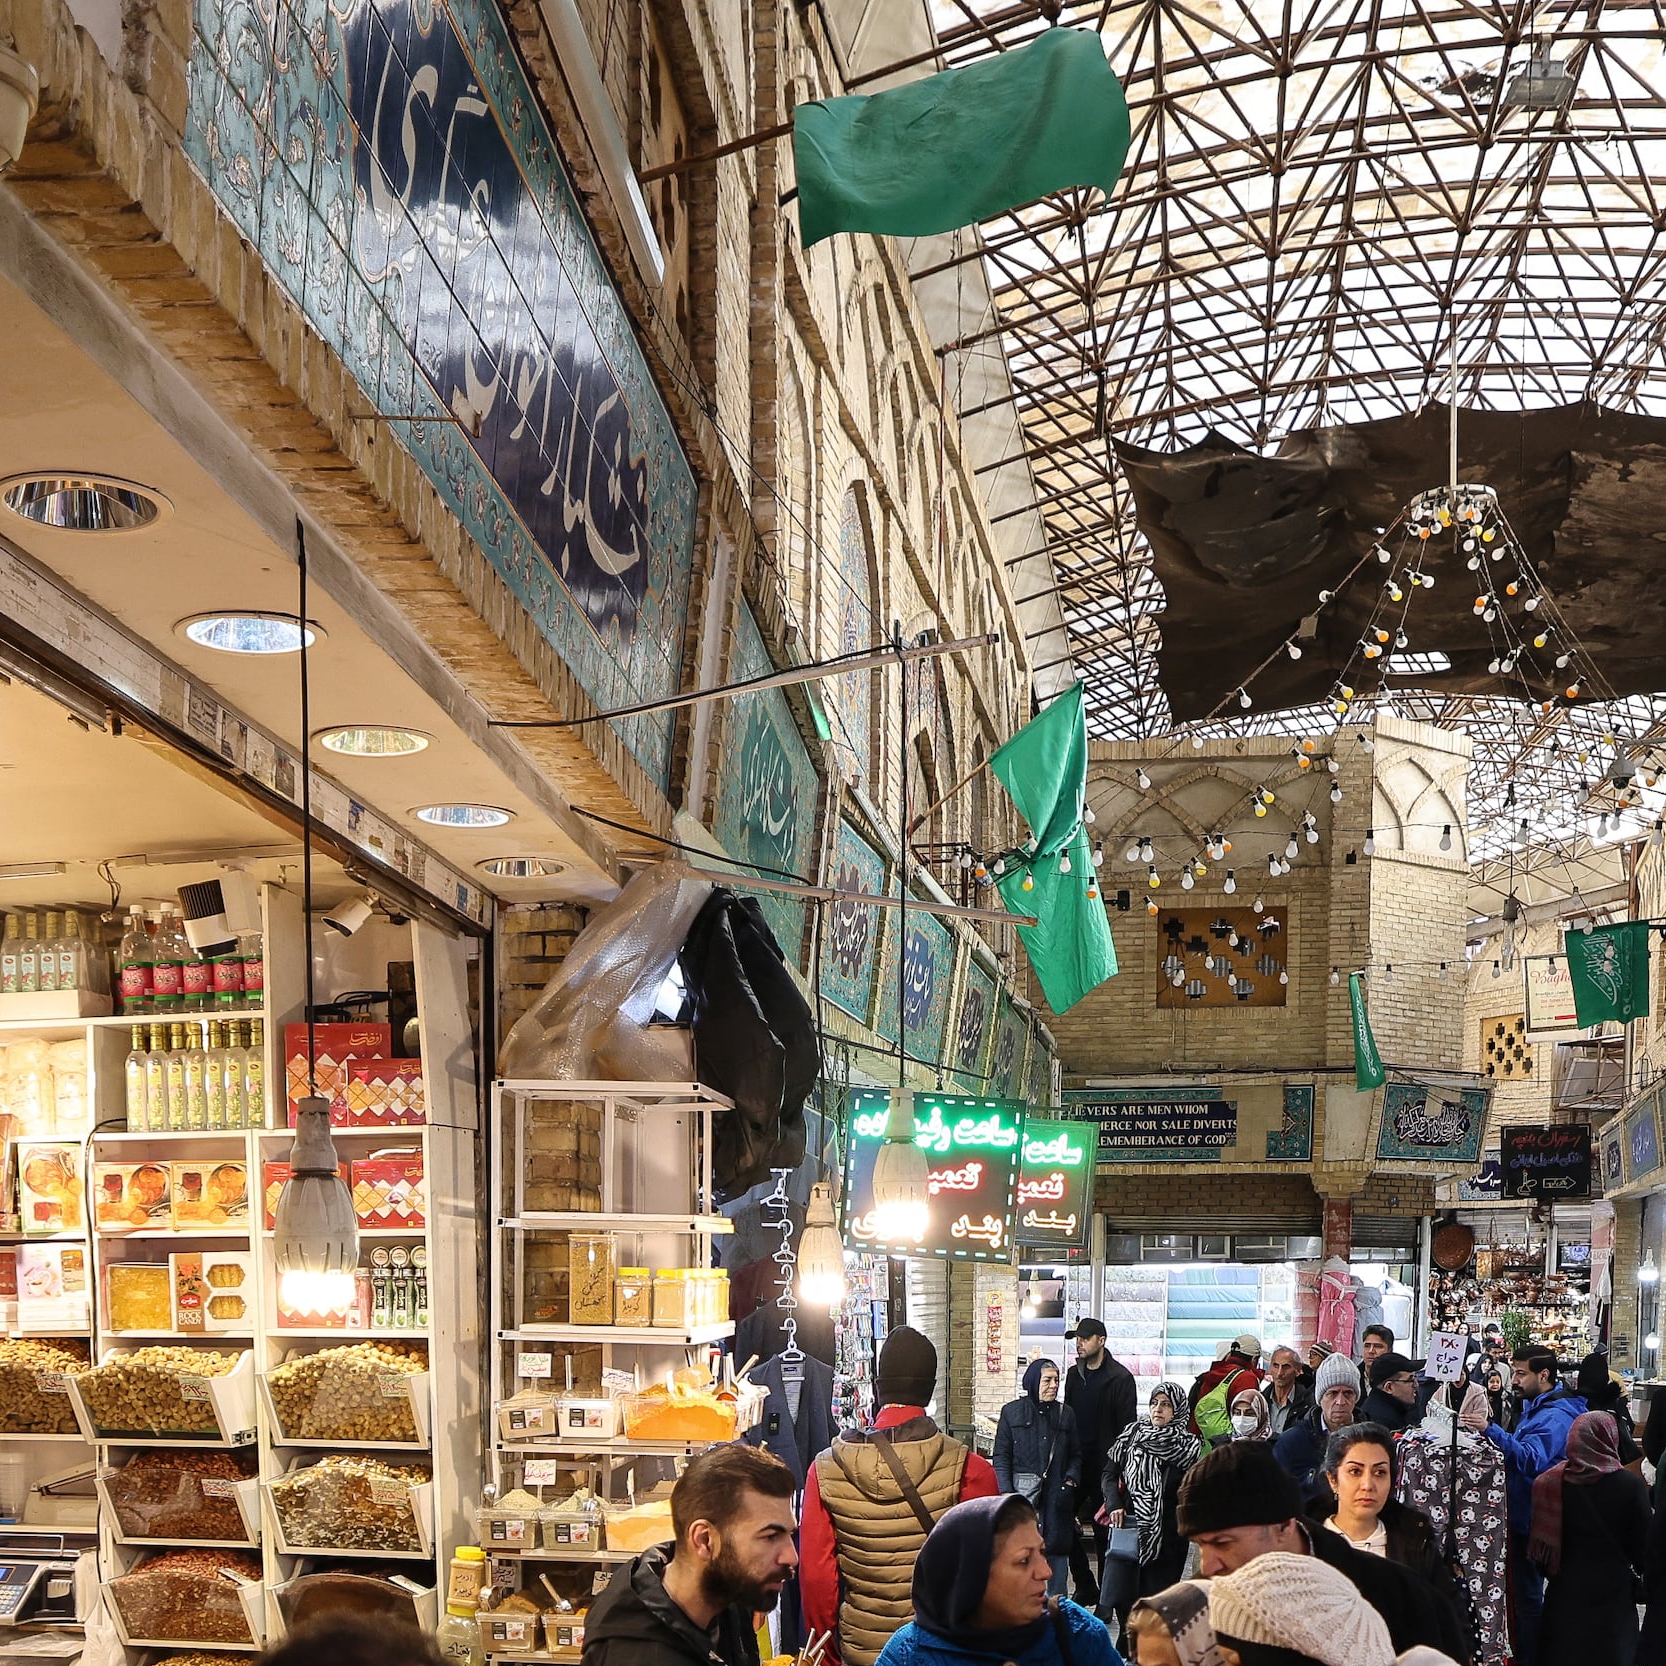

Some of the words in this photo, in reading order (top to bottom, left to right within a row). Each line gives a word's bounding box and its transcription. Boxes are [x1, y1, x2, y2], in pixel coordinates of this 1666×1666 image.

[1121, 1105, 1144, 1116] ARE
[1148, 1105, 1171, 1116] MEN
[1175, 1104, 1208, 1115] WHOM
[1135, 1120, 1158, 1131] NOR
[1162, 1120, 1190, 1130] SALE
[1098, 1135, 1185, 1146] EMEMBERANCE
[1188, 1135, 1202, 1146] OF
[1022, 1209, 1077, 1236] بند
[951, 1214, 1004, 1248] بند
[178, 1311, 202, 1320] ROCK
[1436, 1352, 1459, 1364] حراج
[1436, 1363, 1453, 1374] ۲۵۰
